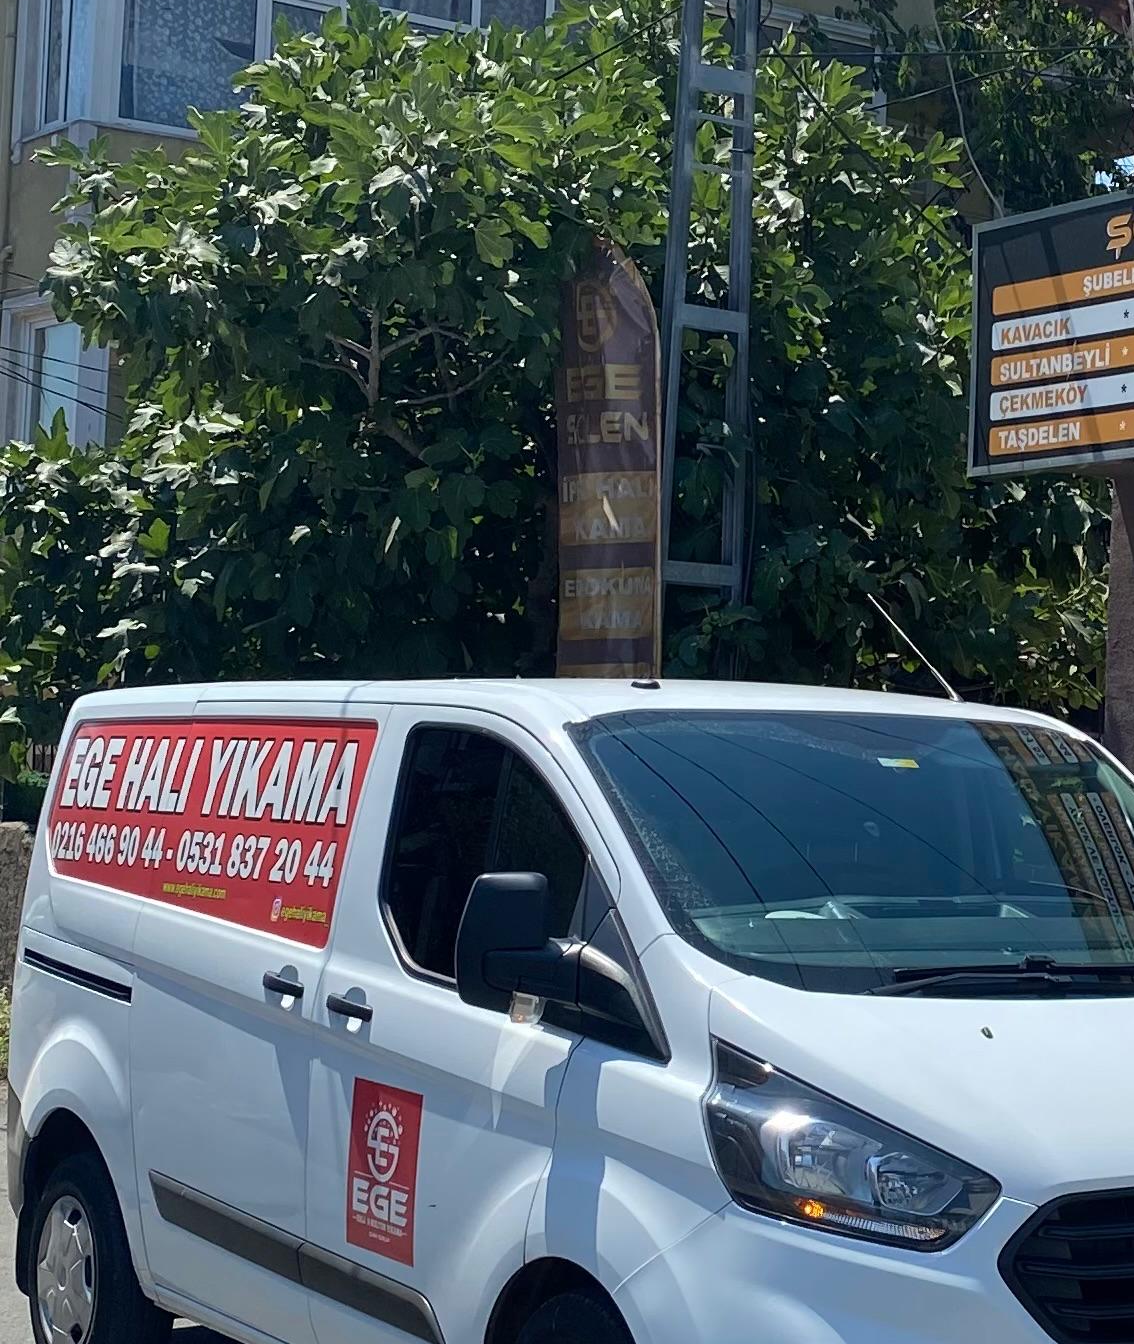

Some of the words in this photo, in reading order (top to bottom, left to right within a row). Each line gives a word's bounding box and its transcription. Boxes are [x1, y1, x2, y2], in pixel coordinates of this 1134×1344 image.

[1001, 318, 1071, 345] KAVACIK
[1000, 342, 1111, 382] SULTANBEYLİ
[999, 381, 1088, 419] ÇEKMEKÖY
[998, 422, 1081, 451] TAŞDELEN
[59, 735, 127, 810] EGE
[117, 737, 205, 815] HALI
[201, 737, 361, 826] YIKAMA
[52, 821, 85, 862] 0216
[86, 822, 117, 865] 466
[117, 825, 141, 867] 90
[141, 827, 167, 869] 44
[176, 829, 227, 876] 0531
[226, 834, 272, 881] 837
[269, 838, 302, 885] 20
[304, 841, 338, 888] 44
[352, 1177, 409, 1227] EGE
